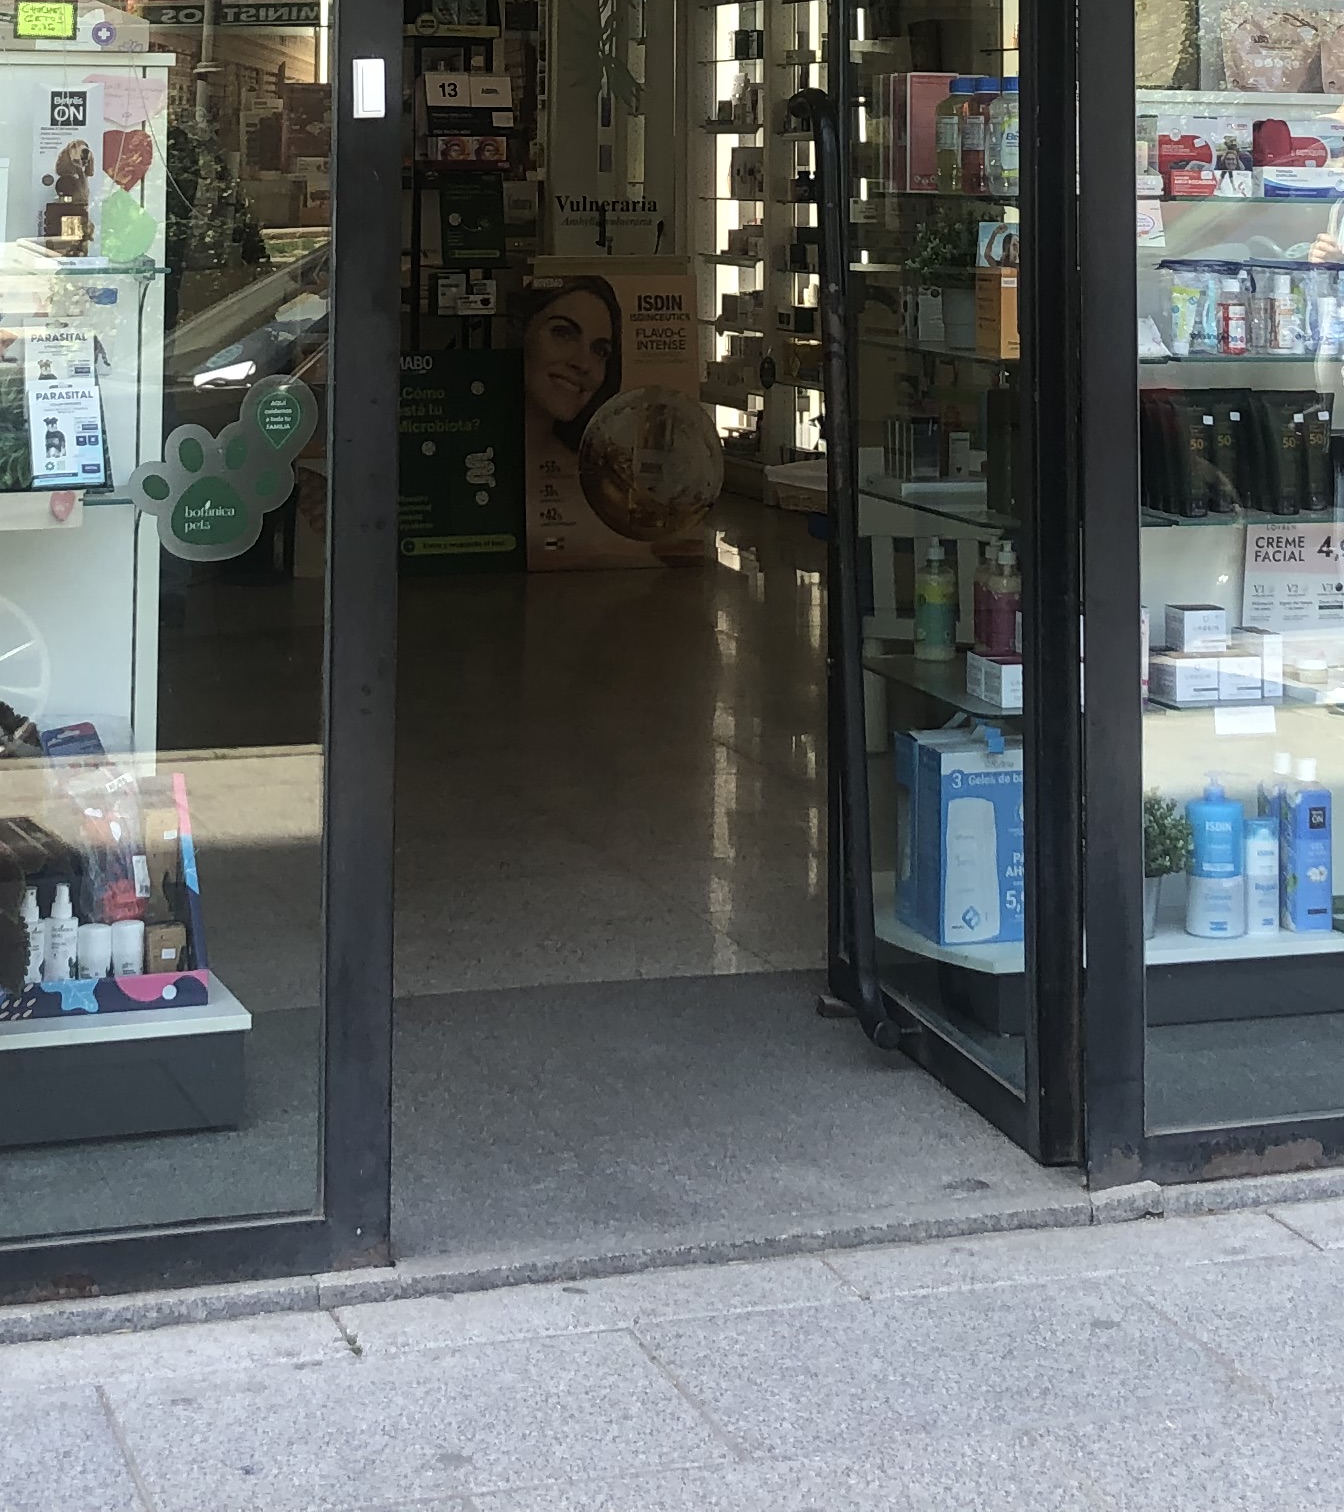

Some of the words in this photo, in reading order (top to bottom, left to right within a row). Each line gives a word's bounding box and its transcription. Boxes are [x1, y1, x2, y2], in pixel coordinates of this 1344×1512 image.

[437, 82, 459, 99] 13
[53, 105, 85, 121] ON
[555, 195, 658, 213] Vulneraria
[636, 294, 683, 312] ISDIN
[30, 332, 88, 343] PARASITAL
[635, 328, 687, 339] FLAVO-C
[636, 339, 687, 351] INTENSE
[35, 390, 94, 401] PARASITAL
[184, 520, 211, 533] pets
[1255, 536, 1306, 549] CREME
[1254, 550, 1306, 563] FACIAL
[951, 772, 963, 789] 3
[968, 774, 996, 786] Geles
[998, 772, 1011, 784] de
[1311, 814, 1325, 824] ON
[1205, 820, 1232, 833] ISDIN
